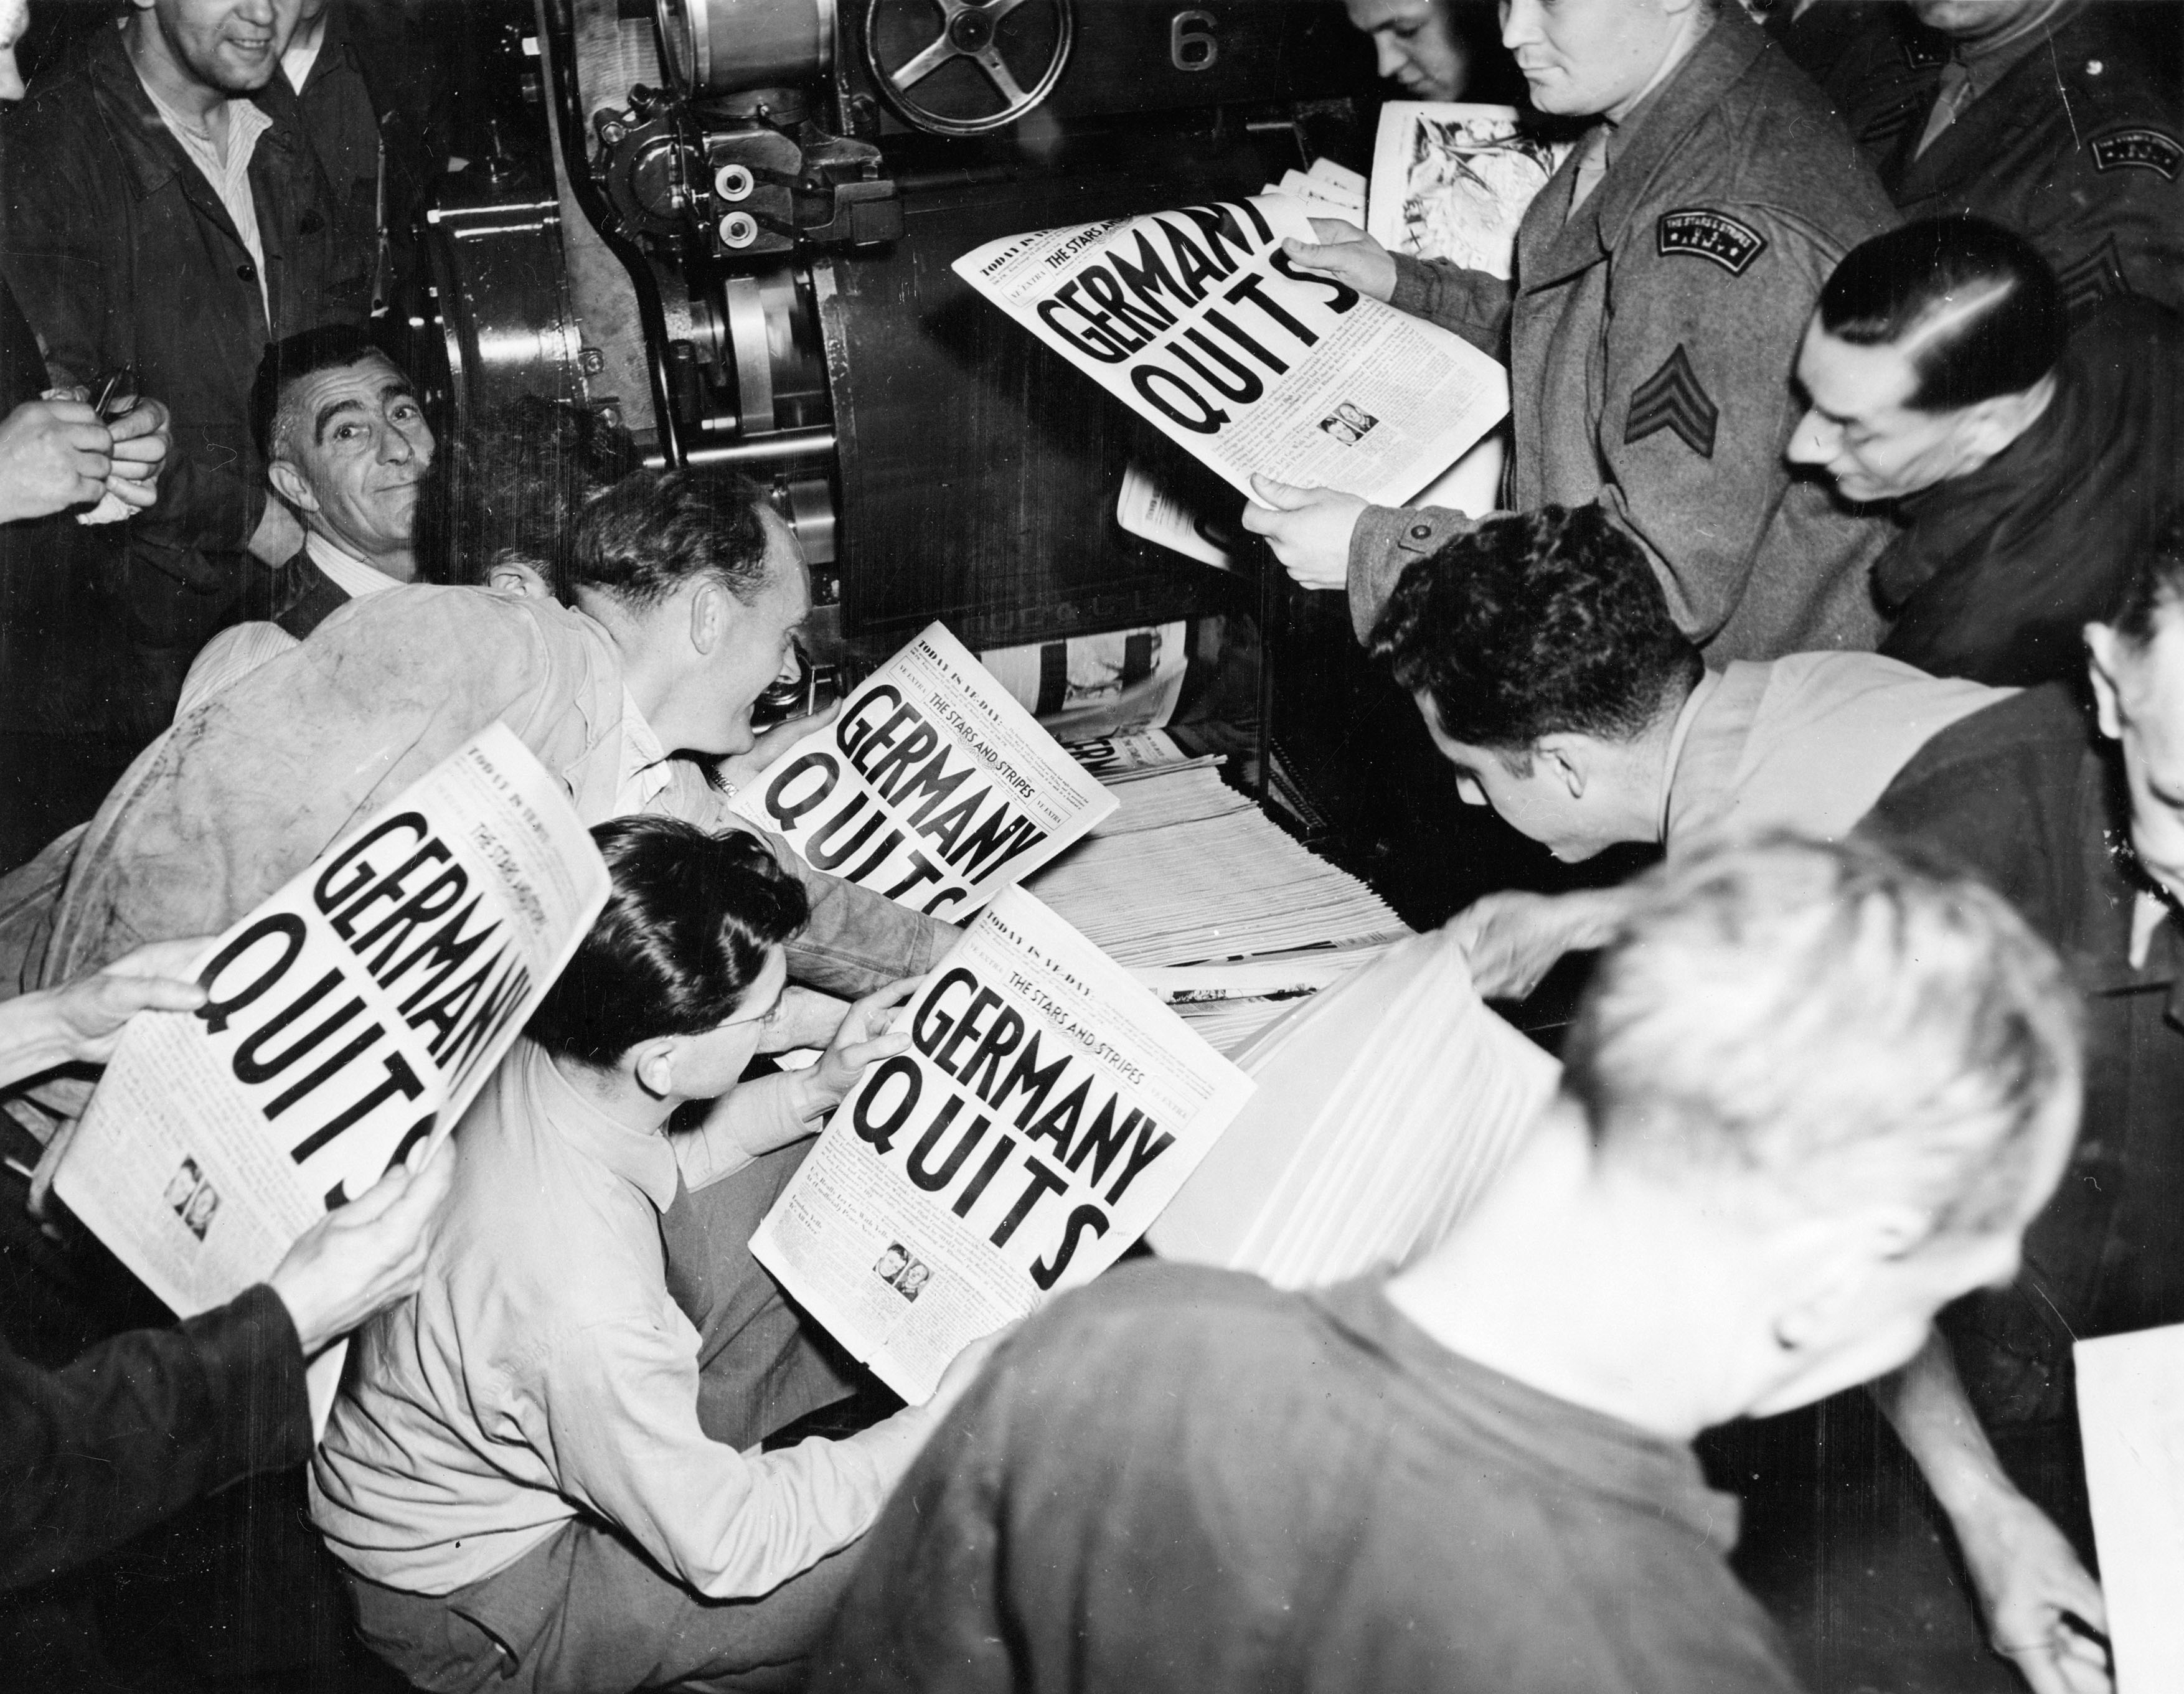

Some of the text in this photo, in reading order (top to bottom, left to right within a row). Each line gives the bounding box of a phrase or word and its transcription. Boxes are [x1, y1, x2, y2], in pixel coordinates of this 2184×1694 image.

[1171, 9, 1218, 71] 6
[979, 247, 1019, 276] TODAY
[1044, 248, 1071, 269] THE
[1065, 227, 1103, 254] STARS
[1130, 247, 1359, 435] QUITS
[906, 672, 927, 694] EXTRA
[918, 639, 949, 671] TODAY
[951, 672, 964, 685] IS
[930, 692, 1035, 798] THE STARS AND STRIPES
[837, 684, 1048, 886] GERMANY
[1044, 807, 1062, 824] EXTRA
[987, 910, 1022, 945] TODAY
[1027, 946, 1040, 958] IS
[1009, 971, 1146, 1085] THE STARS AND STRIPES
[912, 967, 1175, 1207] GERMANY
[853, 1055, 1110, 1291] QUITS
